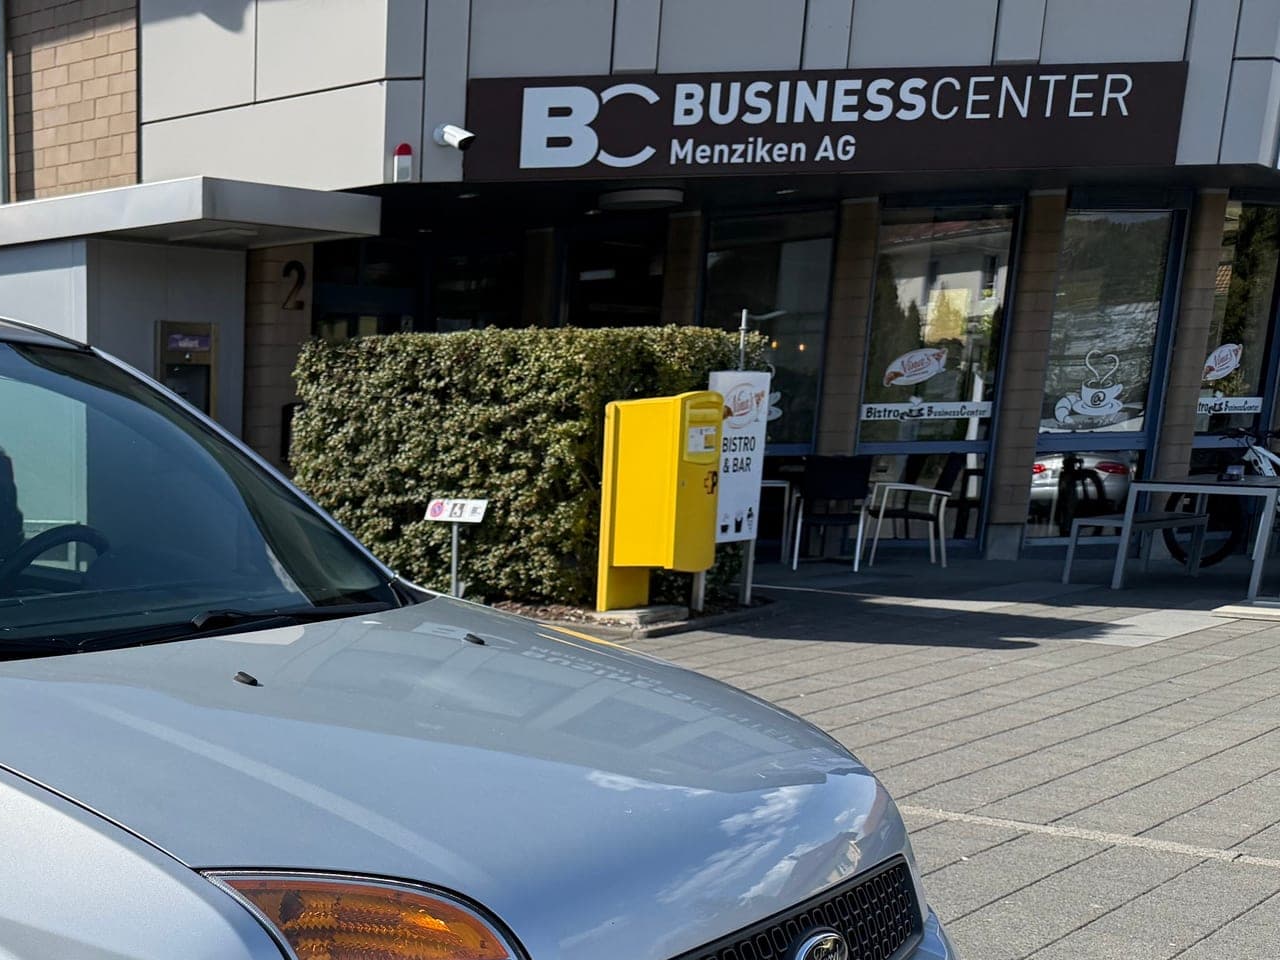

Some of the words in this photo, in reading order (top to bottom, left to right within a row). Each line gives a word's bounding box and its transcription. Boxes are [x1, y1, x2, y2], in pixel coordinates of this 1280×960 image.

[672, 73, 1133, 126] BUSINESSCENTER
[518, 83, 660, 170] BC
[669, 137, 806, 166] Menziken
[815, 135, 857, 162] AG
[282, 260, 305, 311] 2
[866, 406, 900, 418] Bistro
[722, 436, 756, 453] BISTRO
[723, 459, 730, 473] &
[732, 457, 752, 473] BAR
